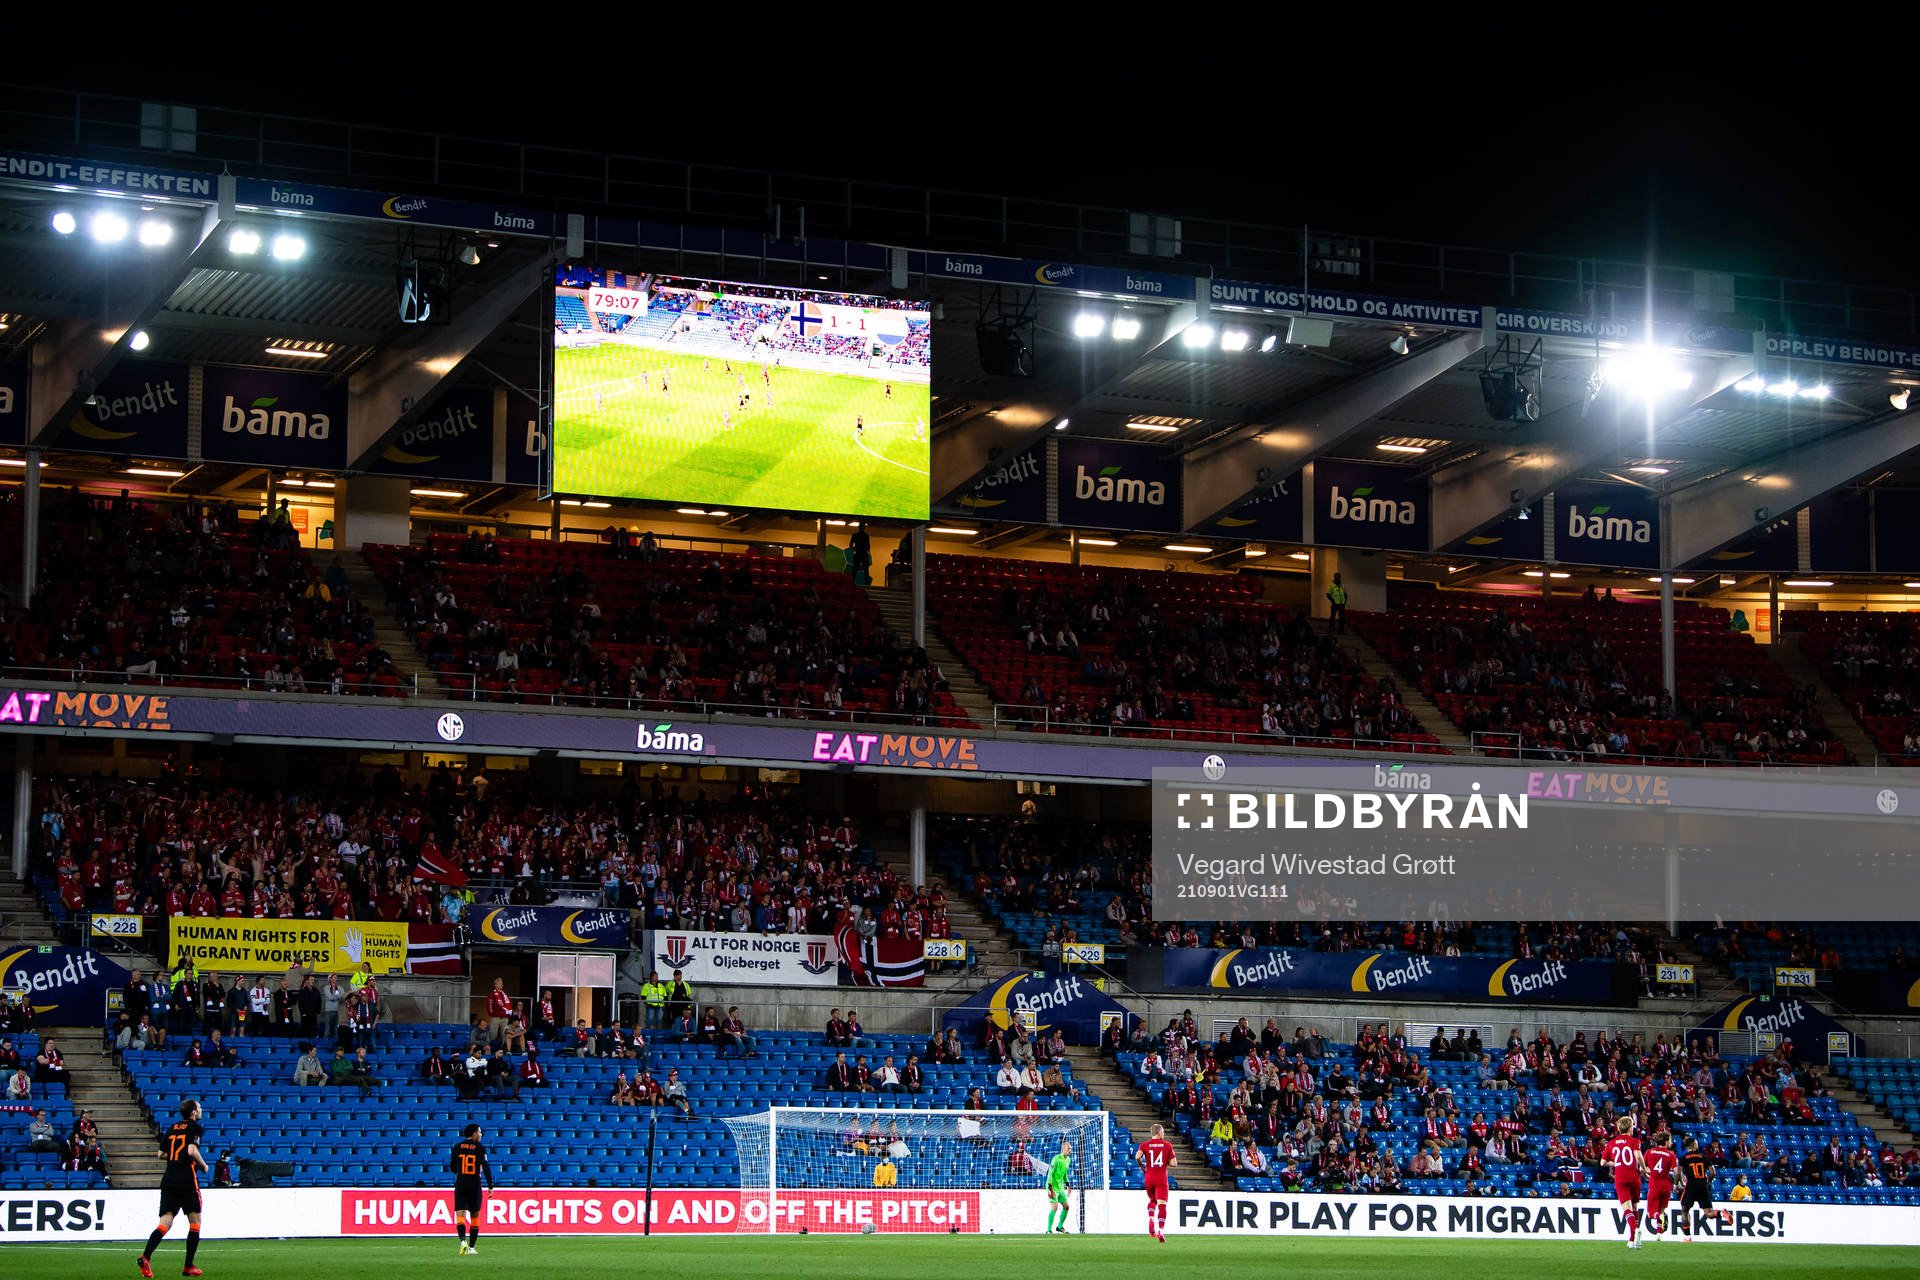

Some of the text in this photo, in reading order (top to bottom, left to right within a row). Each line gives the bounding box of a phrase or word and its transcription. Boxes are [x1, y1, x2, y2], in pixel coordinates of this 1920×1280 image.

[271, 187, 314, 206] bama
[394, 199, 427, 213] Bendit
[493, 211, 535, 229] bama
[945, 257, 983, 275] bama
[1045, 265, 1075, 279] Bendit
[1126, 276, 1162, 292] bama
[594, 293, 640, 310] 79:07
[1211, 285, 1479, 324] SUNT KOSTHOLD OG AKTIVITET
[831, 316, 838, 328] 1
[859, 318, 867, 330] 1
[1496, 312, 1524, 328] GIR
[1767, 338, 1836, 358] OPPLEV
[96, 380, 178, 421] Bendit
[222, 395, 330, 440] bama
[1075, 465, 1165, 505] bama
[1330, 486, 1416, 525] bama
[1568, 505, 1651, 543] bama
[54, 691, 171, 720] MOVE
[637, 723, 704, 752] bama
[812, 732, 976, 762] EAT MOVE
[1374, 764, 1431, 790] bama
[1527, 772, 1669, 799] EAT MOVE
[114, 922, 137, 934] 228
[497, 909, 538, 932] Bendit
[575, 912, 617, 934] Bendit
[177, 926, 330, 943] HUMAN RIGHTS FOR
[365, 938, 401, 947] HUMAN
[692, 937, 801, 953] ALT FOR NORGE
[177, 944, 330, 963] MIGRANT WORKERS
[365, 949, 400, 959] RIGHTS
[927, 946, 948, 957] 228
[1080, 950, 1100, 961] 229
[15, 951, 99, 994] Bendit
[713, 955, 780, 971] Oljeberget
[1233, 950, 1294, 987] Bendit
[1373, 954, 1432, 991] Bendit
[1509, 960, 1567, 996] Bendit
[1660, 970, 1678, 980] 231
[1015, 976, 1083, 1012] Bendit
[1745, 1000, 1805, 1032] Bendit
[168, 1134, 186, 1161] 17
[1612, 1146, 1634, 1167] 20
[458, 1154, 477, 1175] 18
[1148, 1149, 1164, 1168] 14
[1653, 1157, 1664, 1174] 4
[1688, 1162, 1705, 1179] 10
[0, 1199, 105, 1232] ERS!
[355, 1199, 472, 1225] HUMA
[486, 1199, 603, 1225] RIGHTS
[611, 1199, 659, 1225] ON
[667, 1199, 736, 1224] AND
[813, 1199, 873, 1224] THE
[882, 1200, 968, 1224] PITCH
[1179, 1199, 1259, 1229] FAIR
[1269, 1201, 1358, 1231] PLAY
[1368, 1203, 1438, 1232] FOR
[1448, 1205, 1602, 1235] MIGRANT
